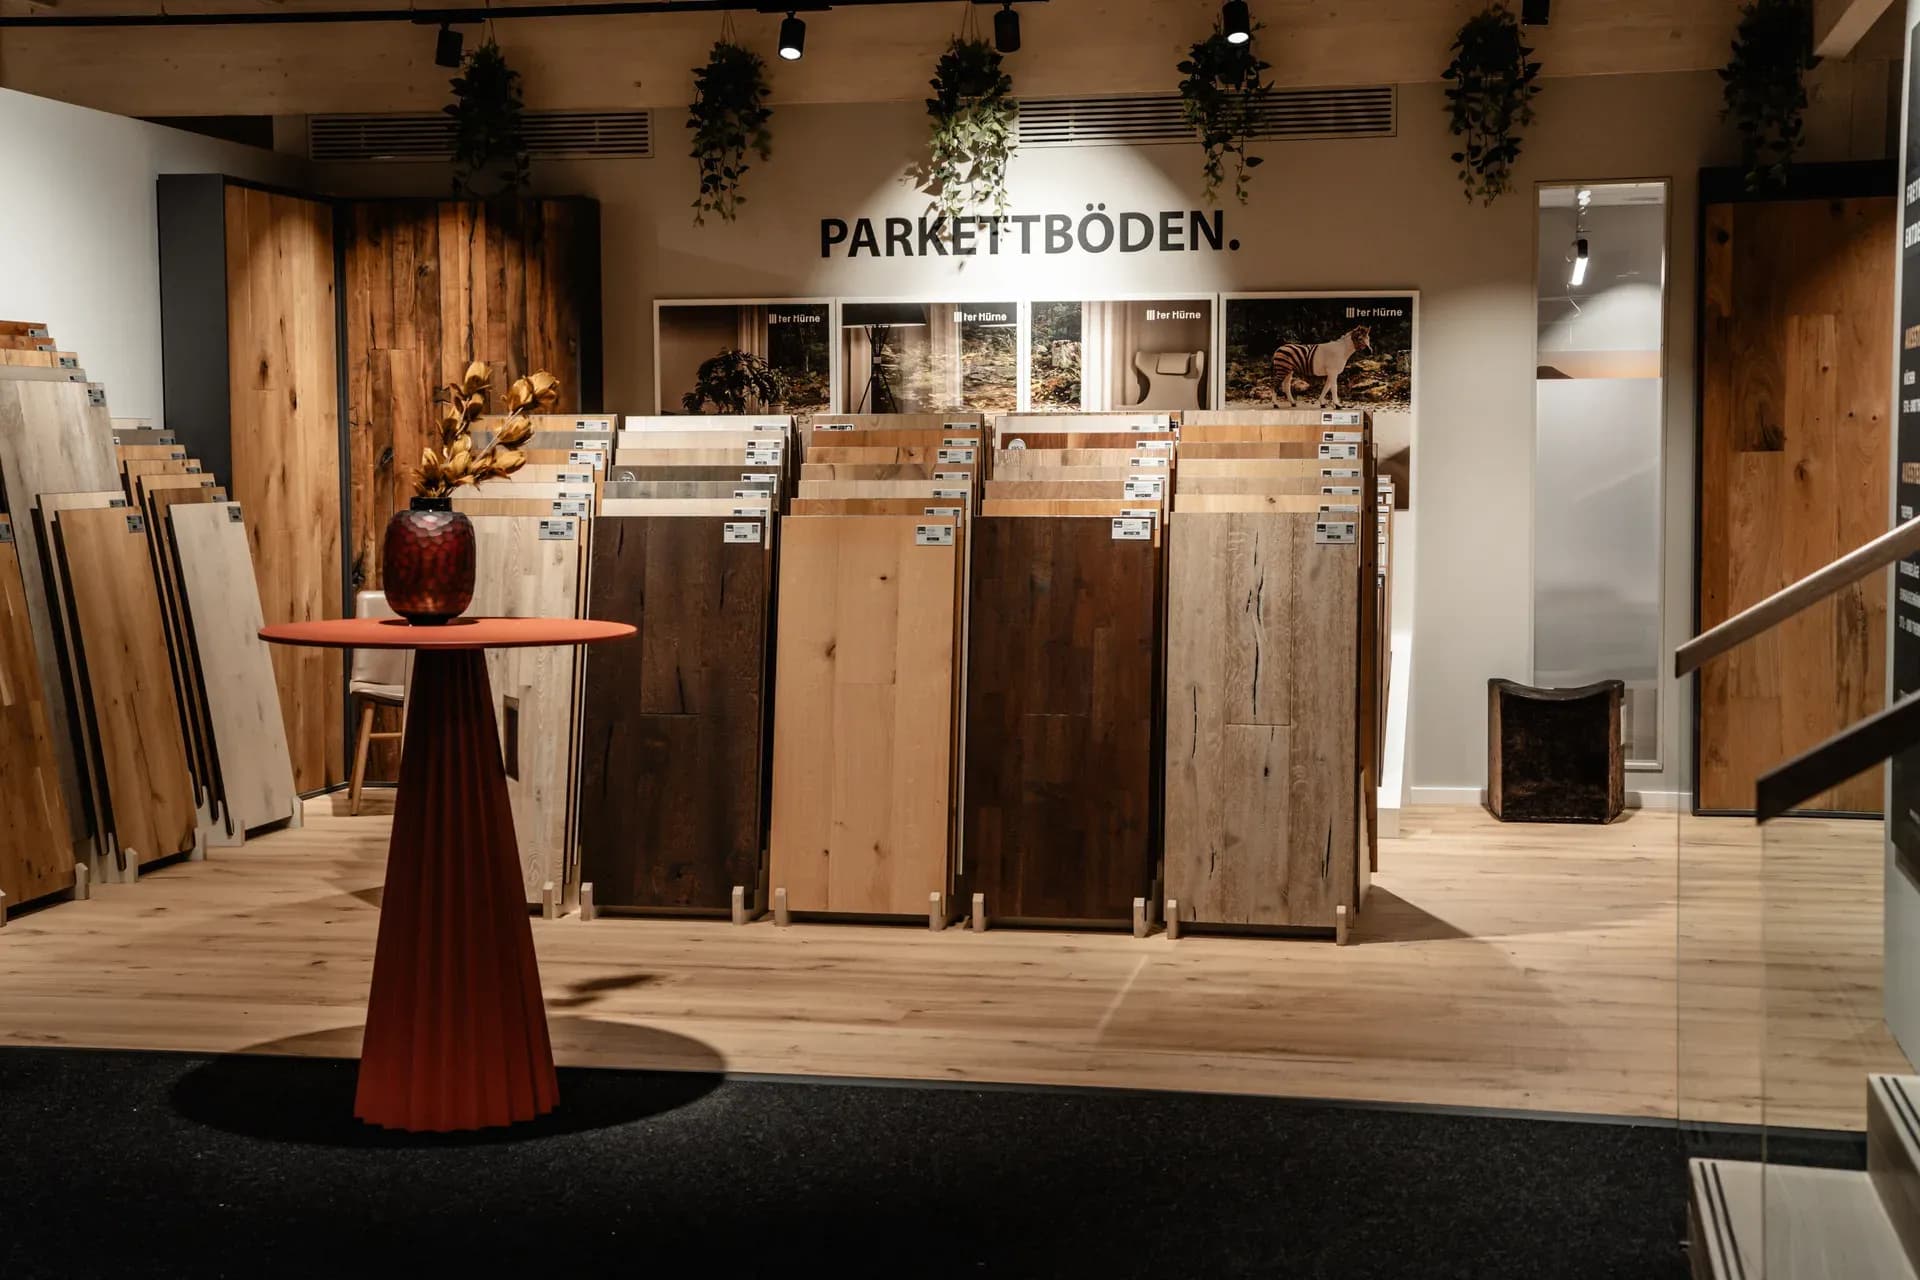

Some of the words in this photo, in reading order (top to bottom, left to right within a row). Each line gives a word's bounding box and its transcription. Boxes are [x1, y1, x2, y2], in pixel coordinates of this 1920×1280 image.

[821, 203, 1241, 257] PARKETTBÖDEN.
[1172, 310, 1201, 320] Hürne
[1372, 307, 1403, 317] Hürne
[793, 313, 821, 323] Hürne
